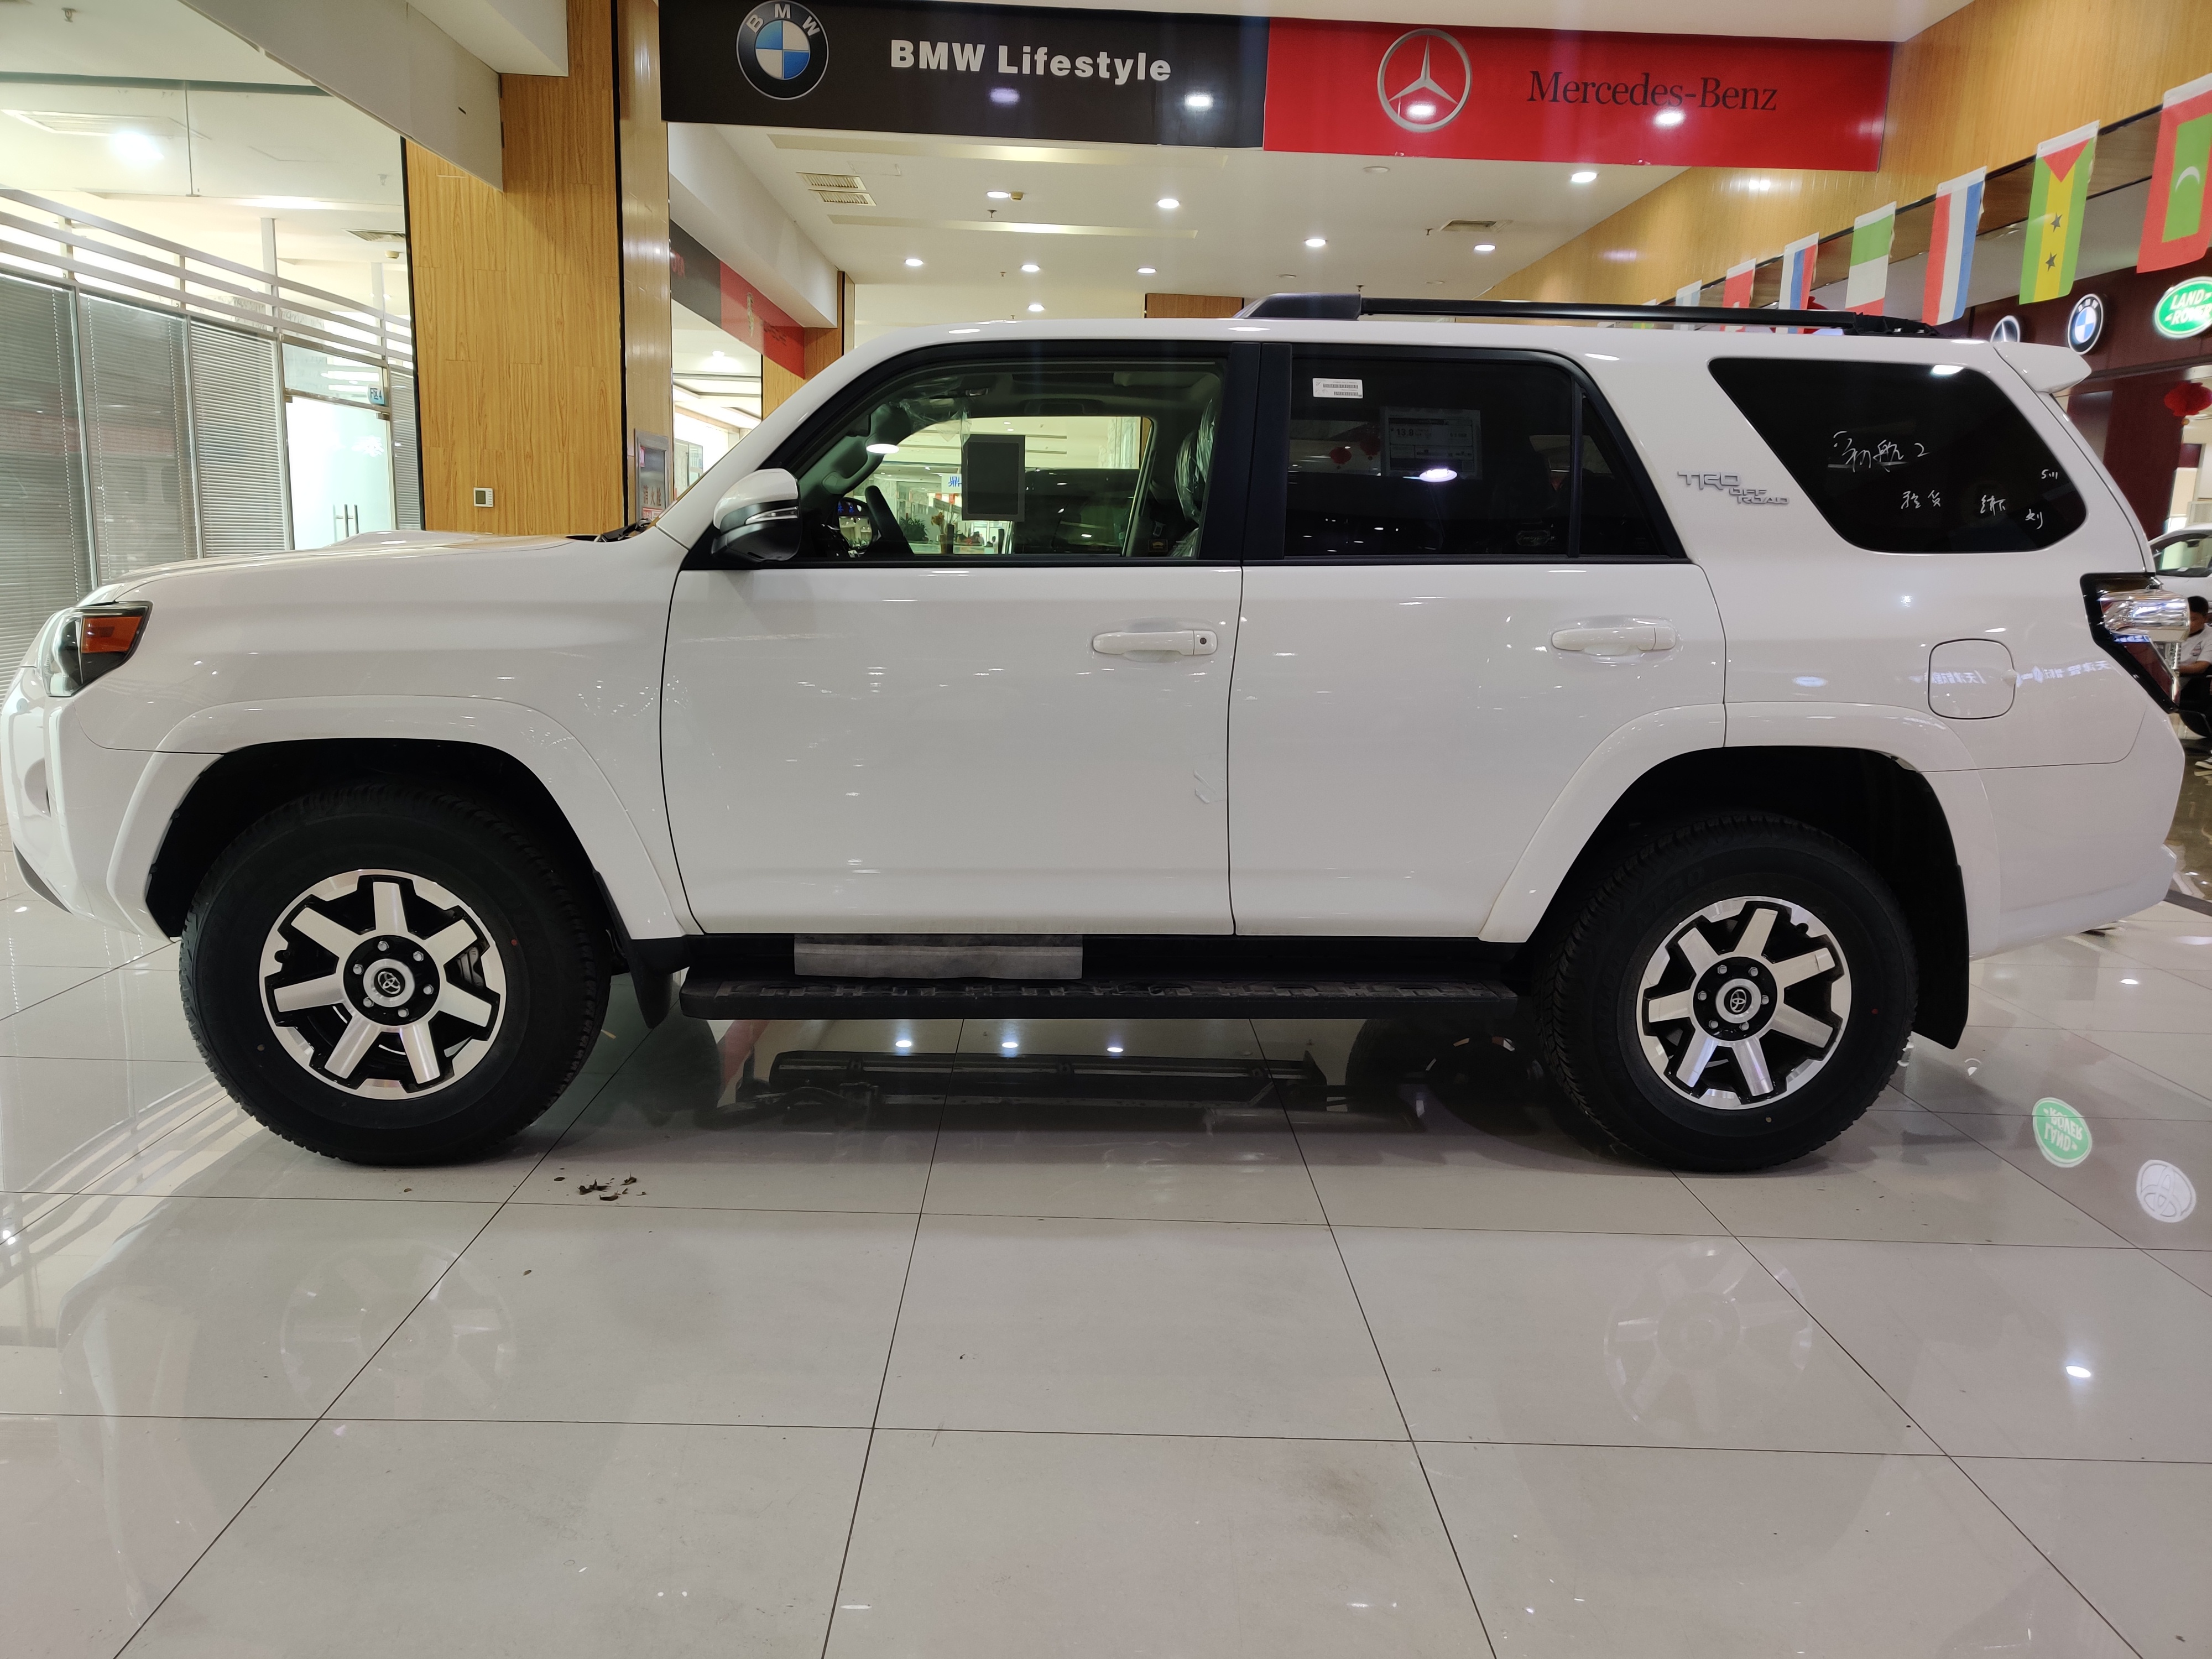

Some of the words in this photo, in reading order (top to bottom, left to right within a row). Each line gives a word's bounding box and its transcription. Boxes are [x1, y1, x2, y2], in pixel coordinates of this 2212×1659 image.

[747, 3, 820, 36] BMW
[891, 39, 985, 72] BMW
[997, 45, 1171, 85] Lifestyle
[1527, 70, 1777, 111] Mercedes-Benz
[2078, 298, 2099, 312] BMW
[2169, 288, 2205, 310] LAND
[1677, 471, 1741, 491] TRD
[1729, 487, 1767, 495] OFF
[1737, 495, 1790, 504] ROAD
